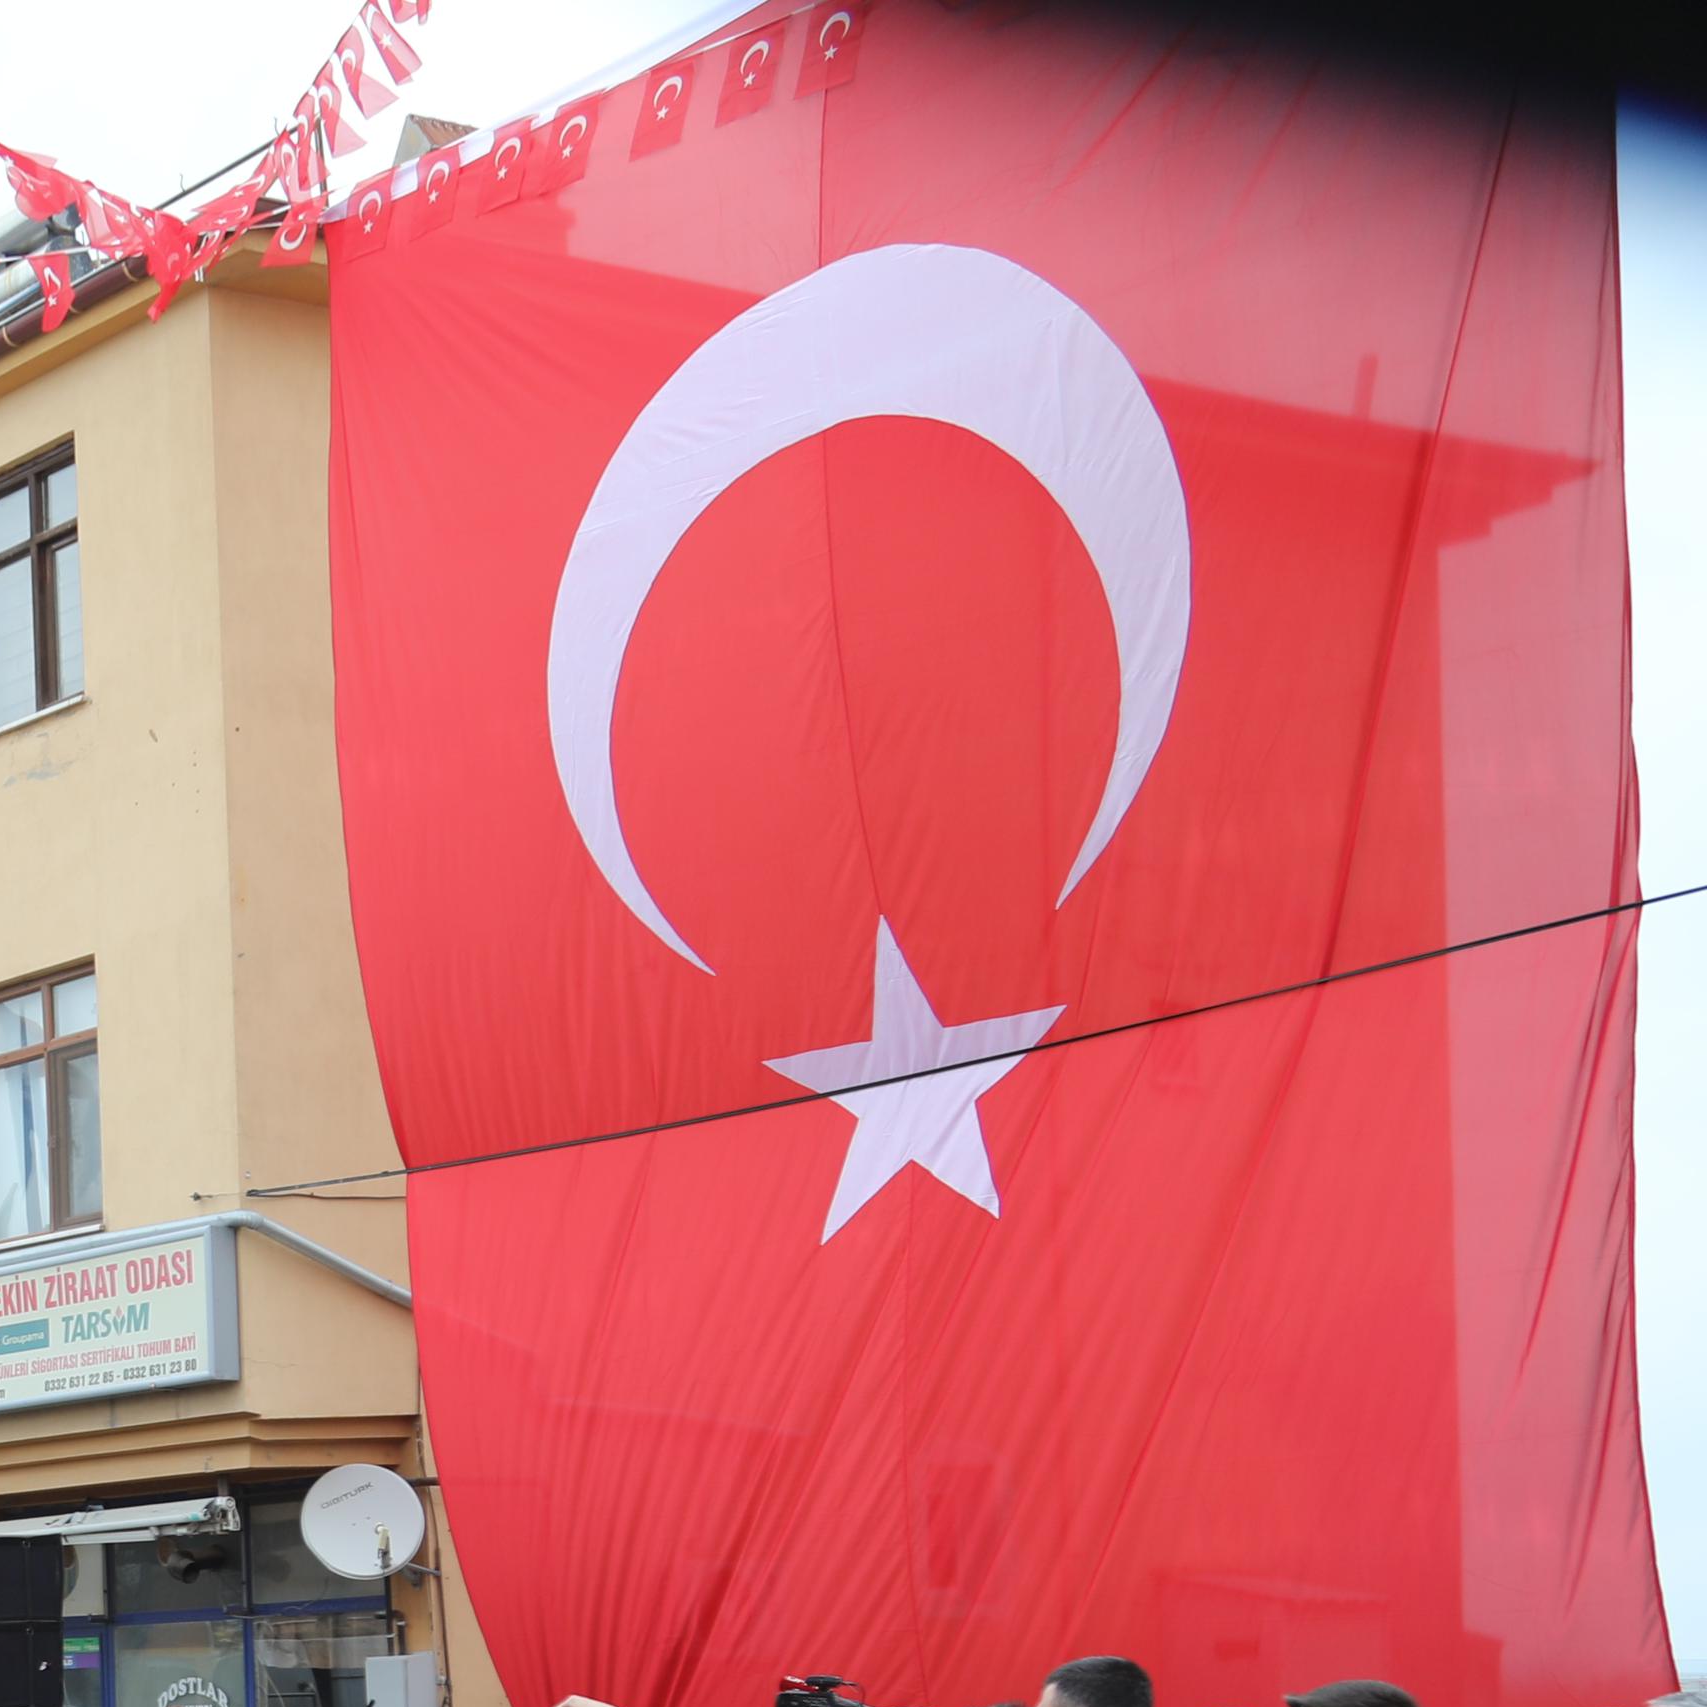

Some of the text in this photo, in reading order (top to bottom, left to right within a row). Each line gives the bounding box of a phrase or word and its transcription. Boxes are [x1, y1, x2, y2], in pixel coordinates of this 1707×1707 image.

[42, 1263, 118, 1309] ZİRAAT
[125, 1249, 194, 1295] ODASI
[2, 1331, 44, 1347] Groupama
[31, 1354, 79, 1375] SİGORTASI
[137, 1339, 172, 1358] TOHUM
[44, 1378, 67, 1392] 0332
[69, 1375, 86, 1388] 631
[89, 1373, 100, 1386] 22
[123, 1365, 147, 1381] 0332
[149, 1363, 167, 1377] 631
[170, 1360, 183, 1374] 23
